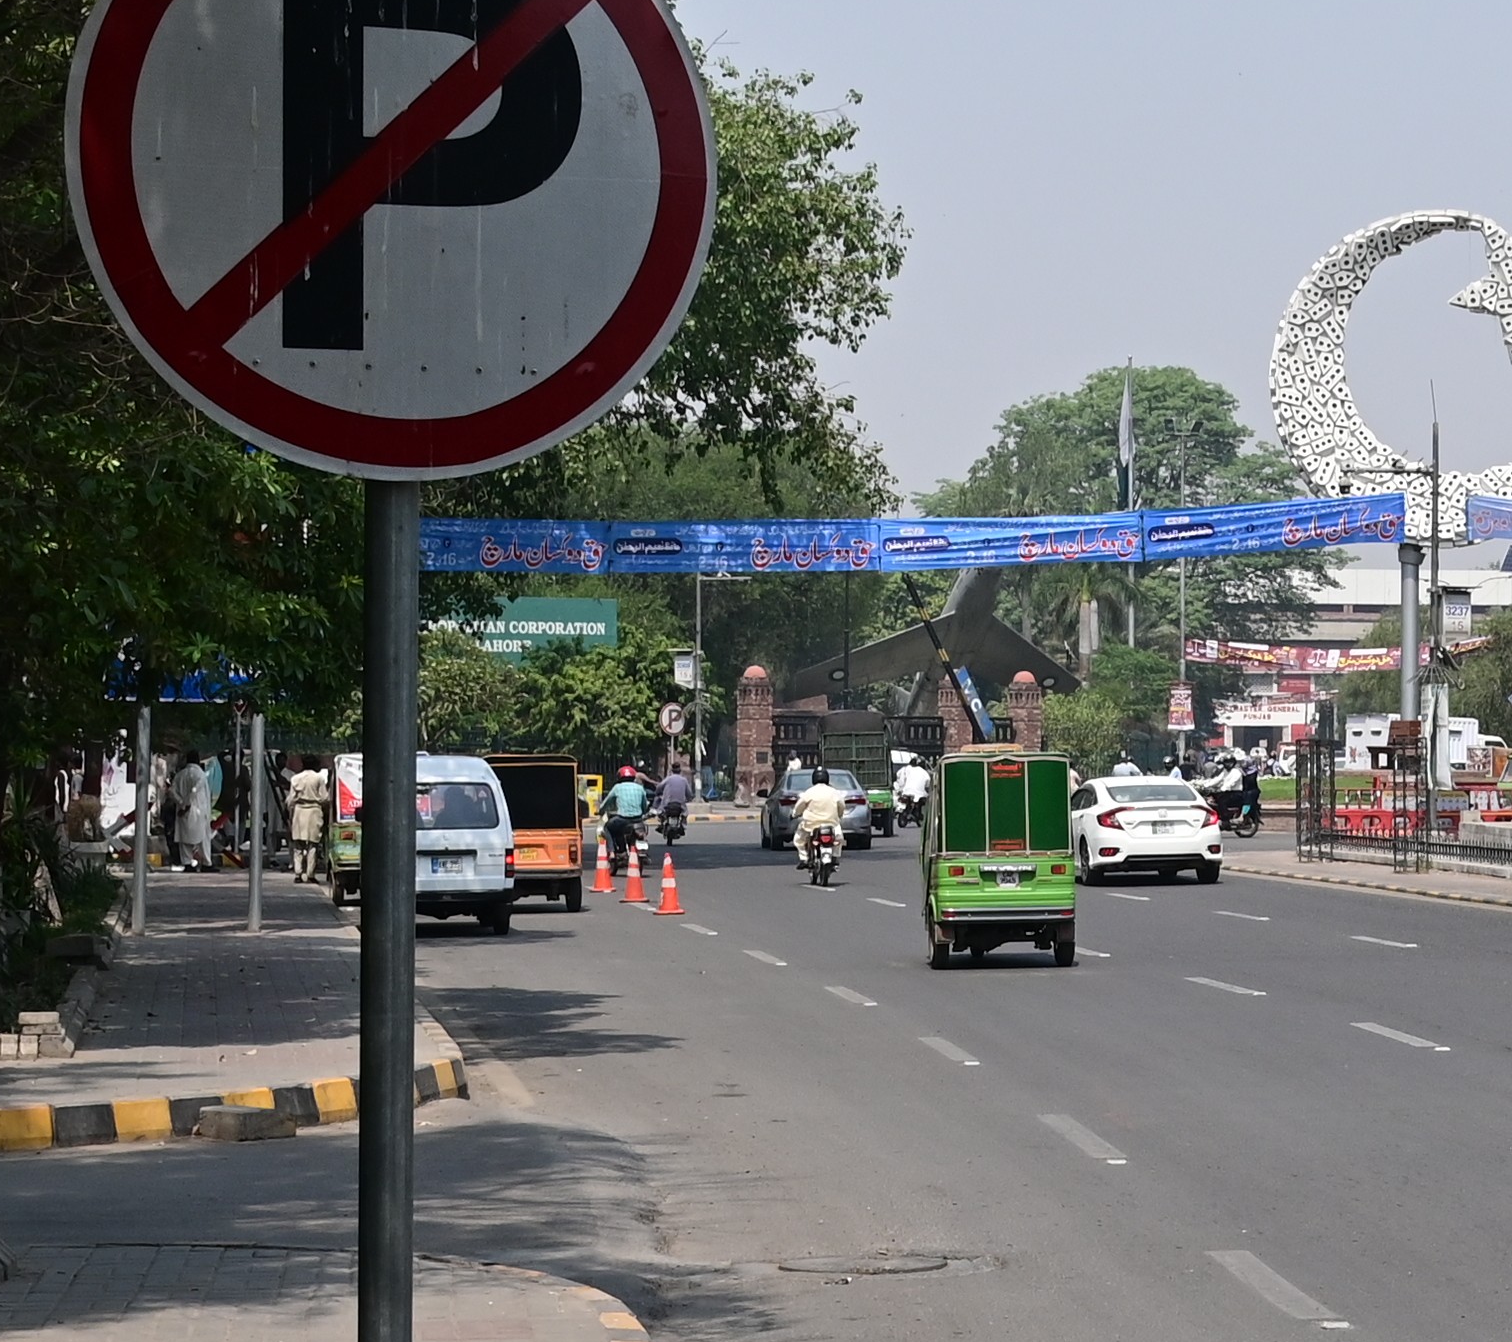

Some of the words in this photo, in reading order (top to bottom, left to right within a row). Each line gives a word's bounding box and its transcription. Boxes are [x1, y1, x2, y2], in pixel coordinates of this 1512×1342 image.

[480, 535, 524, 568] مارچ
[751, 537, 794, 570] مارچ
[1445, 606, 1469, 616] 3237
[509, 620, 606, 636] CORPORATION
[1267, 705, 1301, 713] GENERAL
